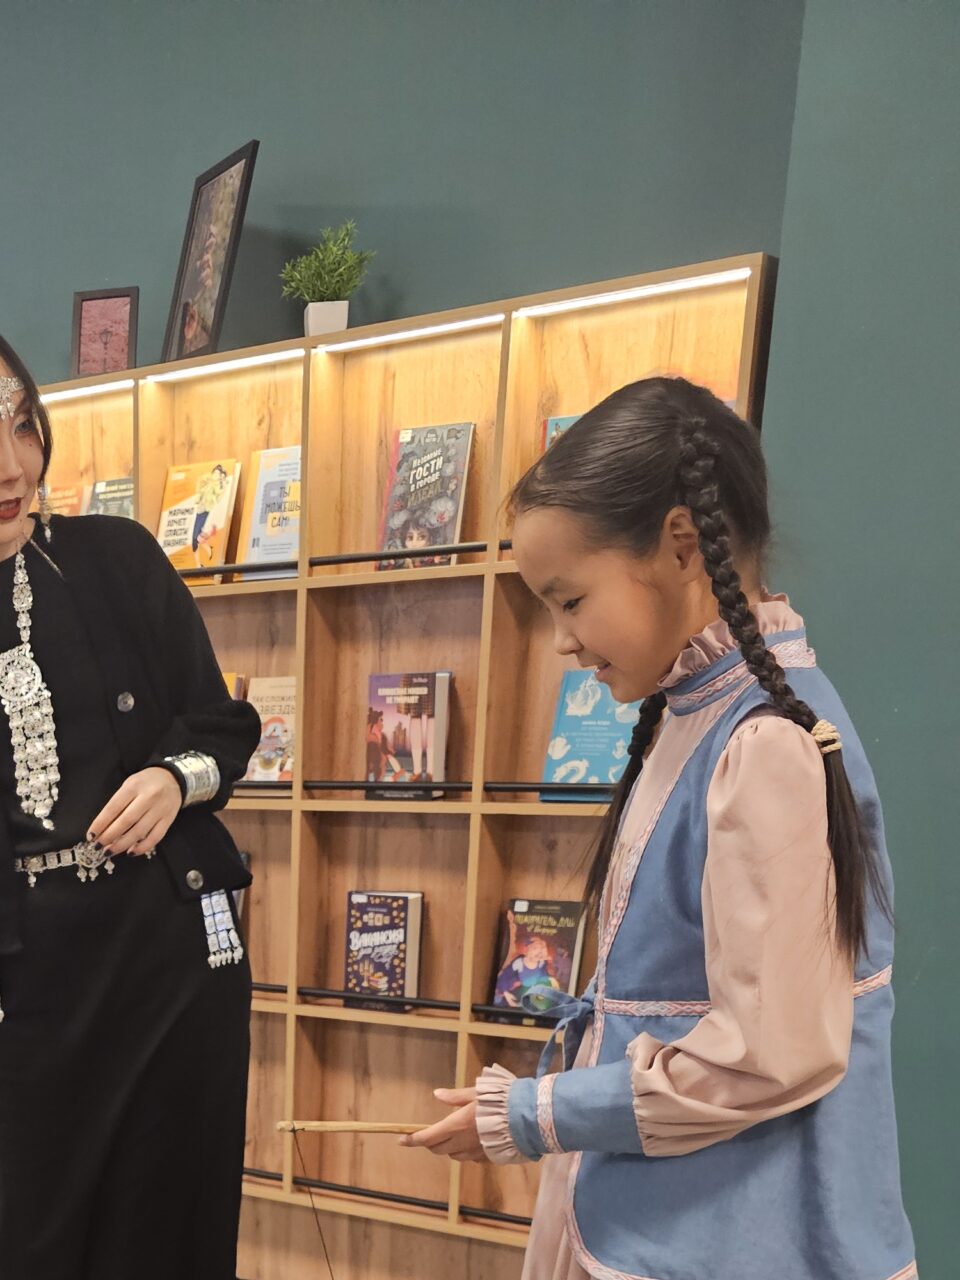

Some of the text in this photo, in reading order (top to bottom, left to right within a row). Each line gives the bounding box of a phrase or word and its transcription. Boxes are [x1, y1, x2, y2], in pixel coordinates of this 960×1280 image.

[409, 456, 443, 484] ГОСТИ
[279, 486, 291, 499] ТЫ
[265, 501, 301, 514] МОЖЕШЬ
